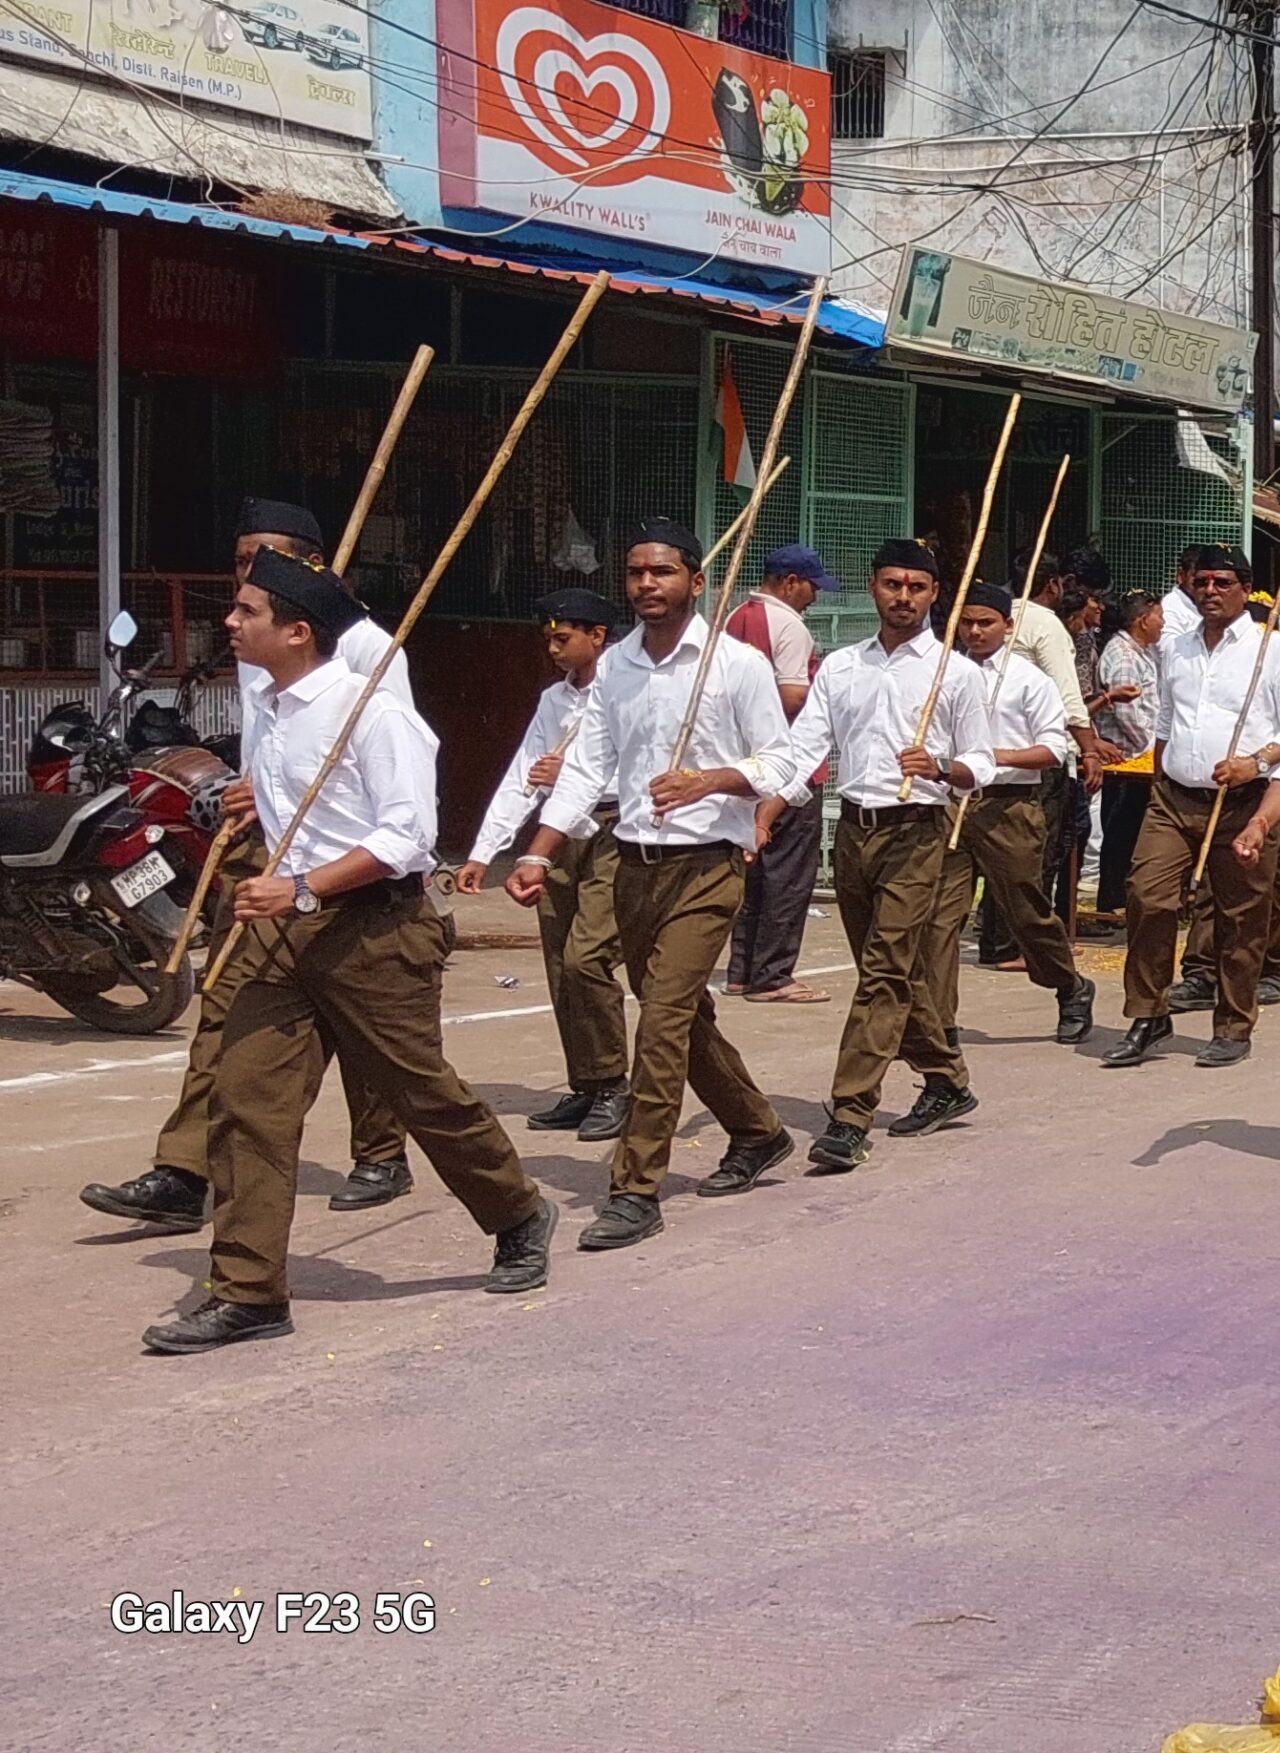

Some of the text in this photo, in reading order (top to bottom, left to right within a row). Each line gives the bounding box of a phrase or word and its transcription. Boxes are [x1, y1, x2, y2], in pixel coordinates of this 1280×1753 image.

[161, 67, 203, 88] Raisen
[208, 77, 242, 101] (M.P.)
[529, 191, 646, 231] KWALITY WALL'S
[705, 210, 796, 242] JAIN CHAI WALA
[760, 244, 782, 259] वाला
[967, 274, 1220, 376] जैन रोहित होटल
